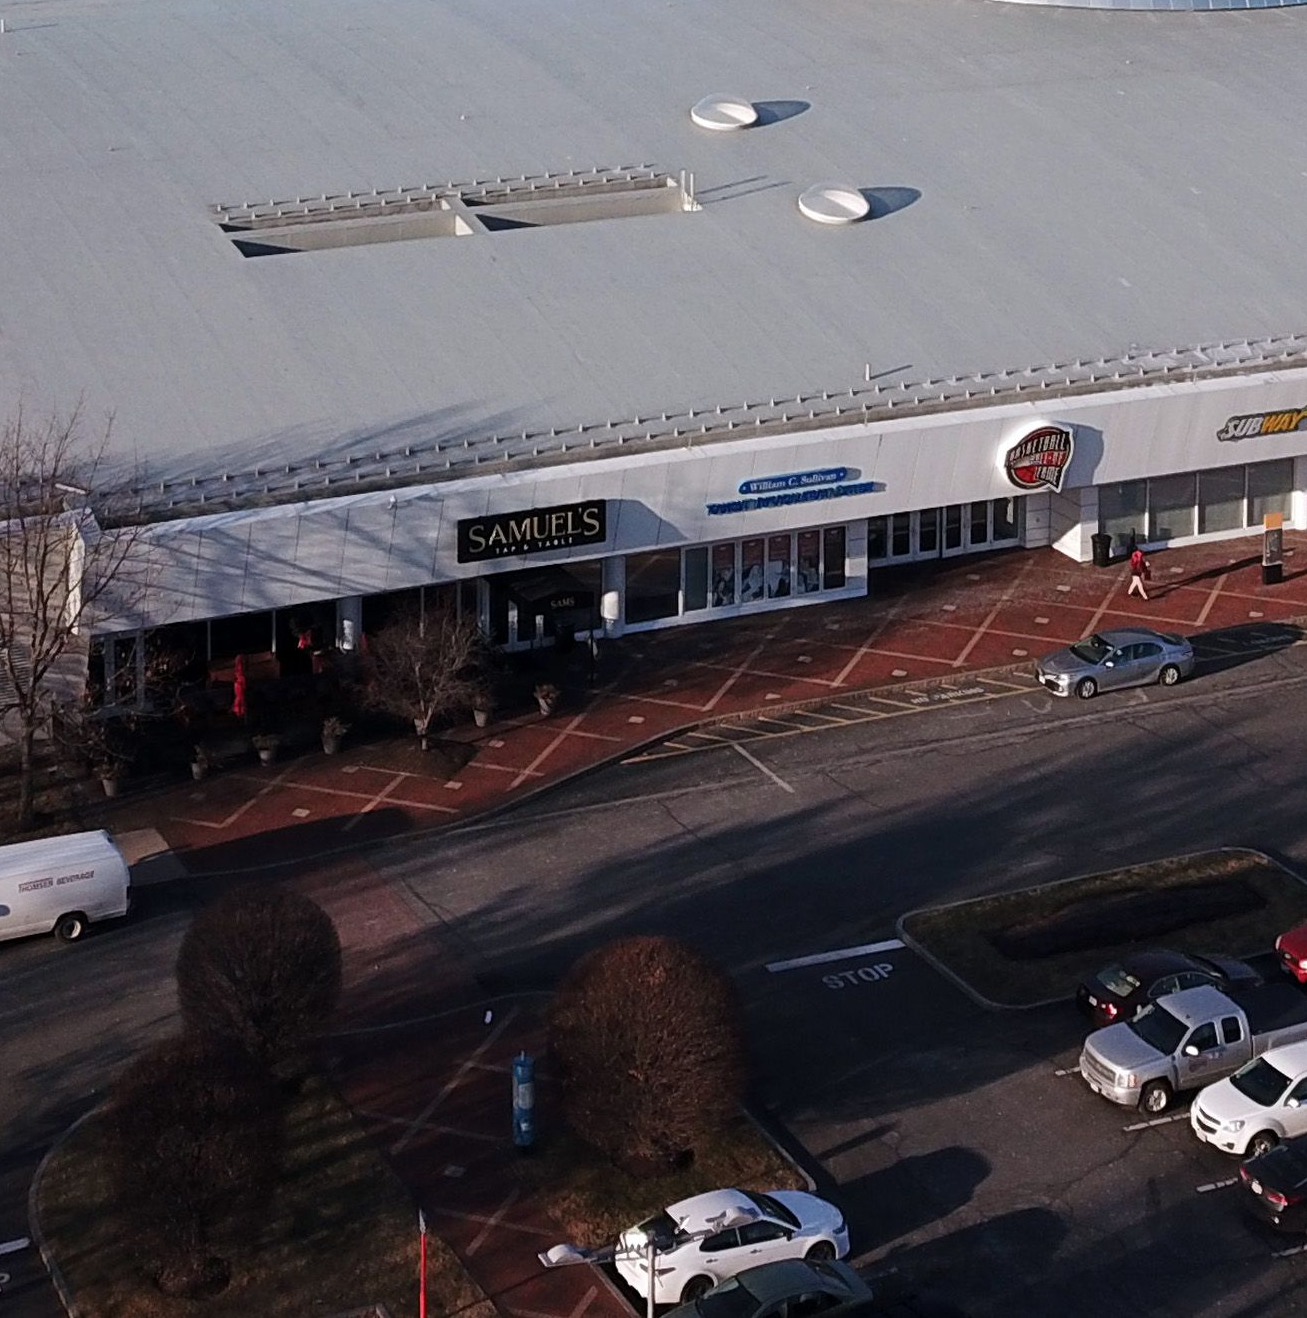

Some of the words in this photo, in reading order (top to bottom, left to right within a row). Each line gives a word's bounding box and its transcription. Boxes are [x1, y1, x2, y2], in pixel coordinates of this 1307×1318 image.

[1009, 433, 1066, 461] BASKETBALL
[749, 480, 786, 492] William
[788, 477, 798, 486] C.
[800, 473, 837, 485] Sullivan
[469, 508, 600, 553] SAMUEL'S
[496, 546, 516, 554] TAP
[538, 537, 573, 548] TABLE
[822, 963, 893, 989] STOP
